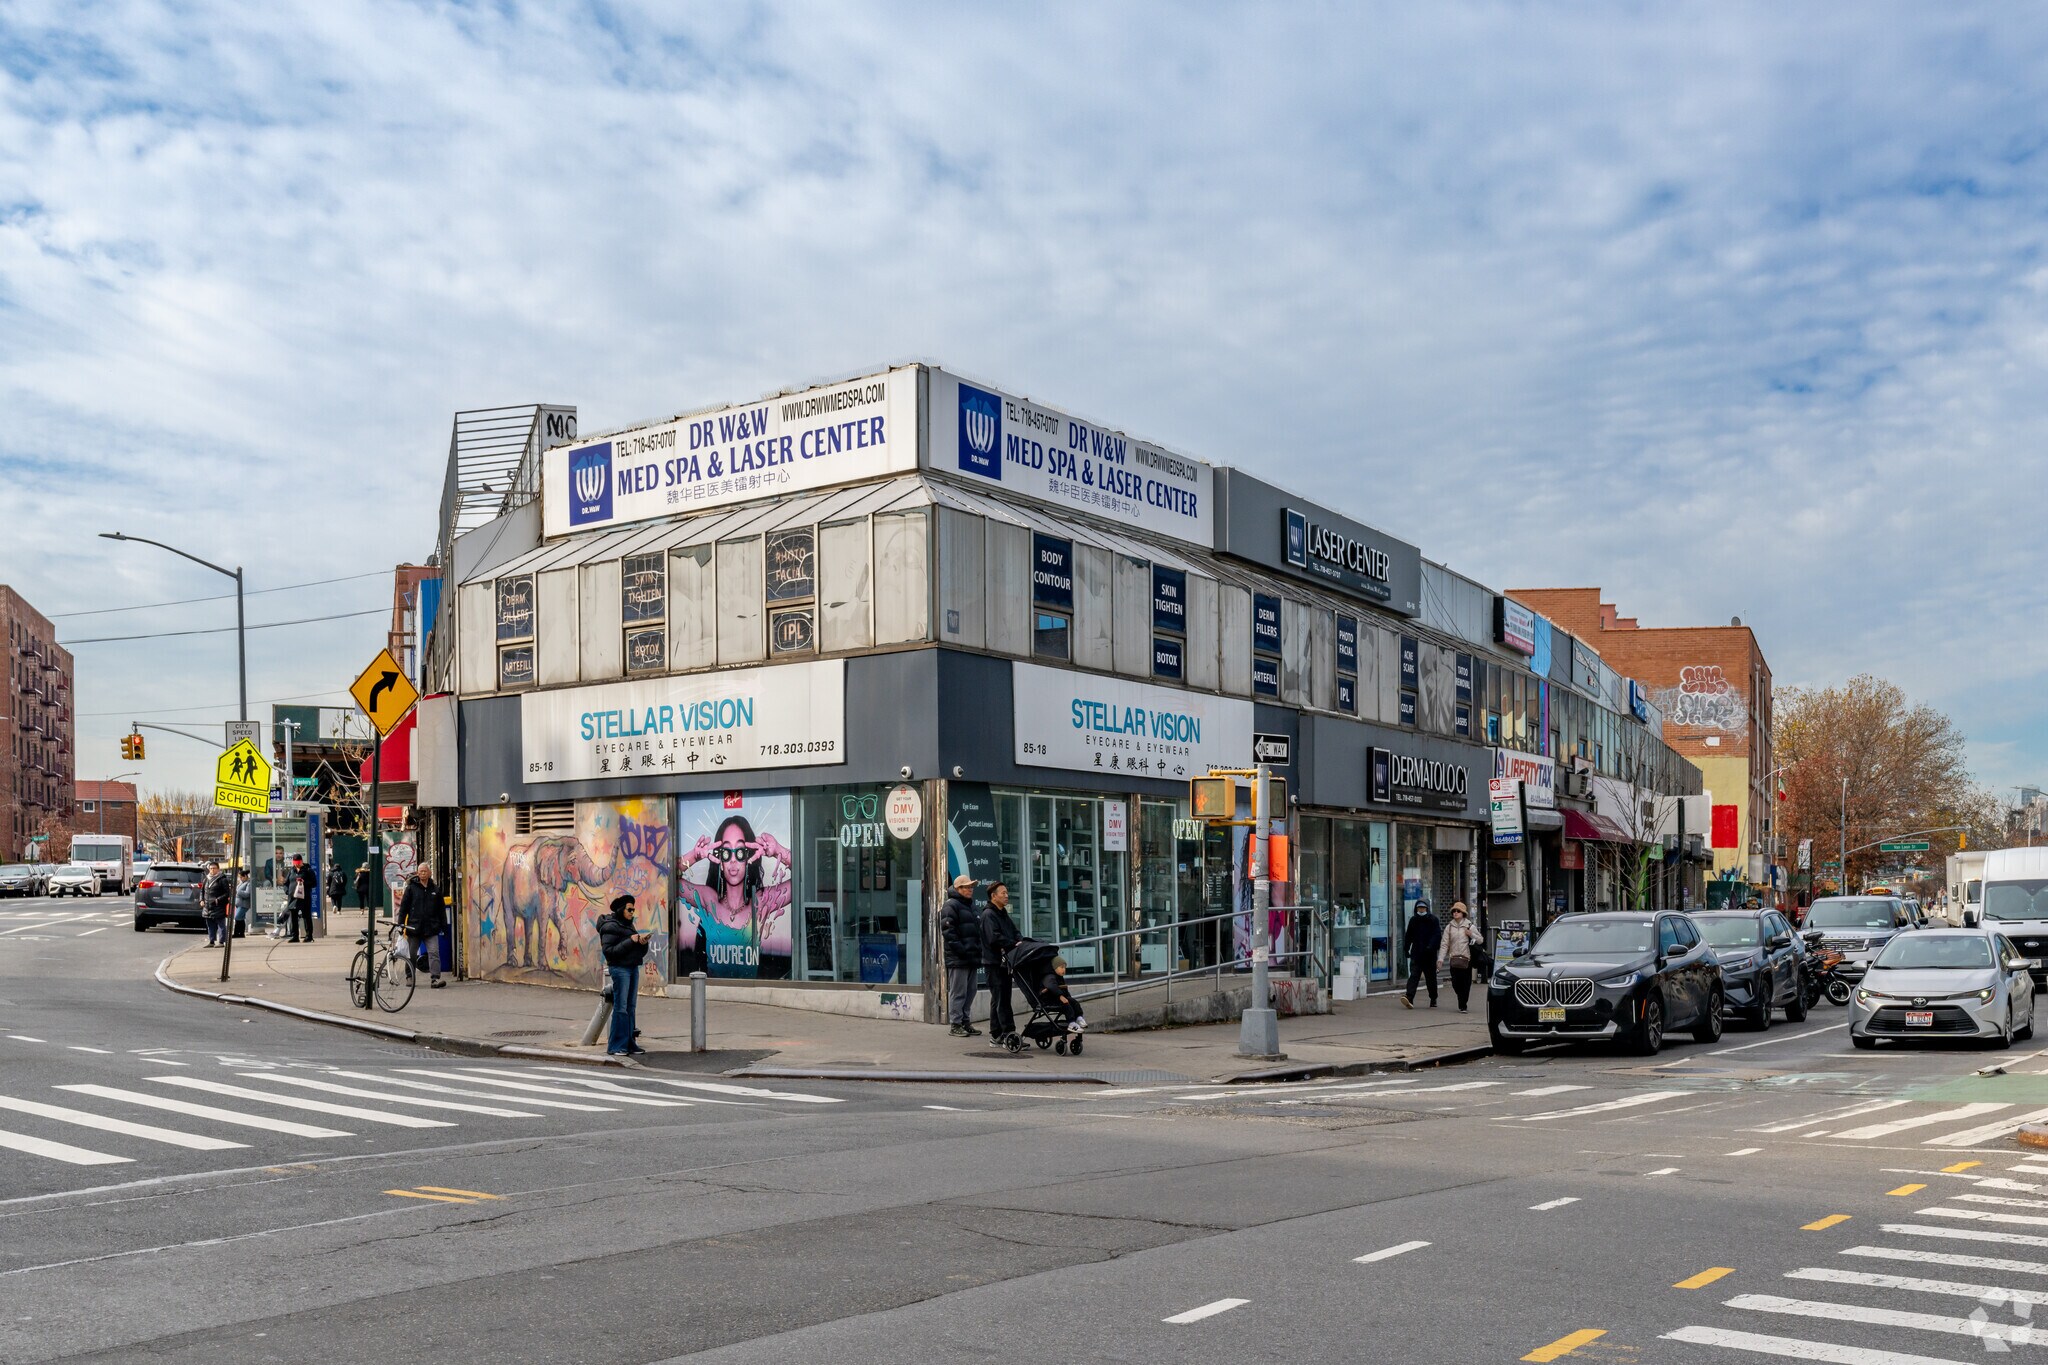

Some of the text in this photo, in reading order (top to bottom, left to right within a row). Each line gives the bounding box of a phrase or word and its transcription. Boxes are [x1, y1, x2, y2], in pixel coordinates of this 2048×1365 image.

[782, 383, 885, 422] WWW.DRWWMEDSPA.COM
[1005, 401, 1059, 436] TEL: 718-457-0707
[690, 407, 769, 450] DR W&W
[616, 430, 677, 458] TEL: 718-457-0707
[1069, 421, 1127, 466] DR W&W
[618, 415, 886, 496] MED SPA & LASER CENTER
[1006, 433, 1198, 518] MED SPA & LASER CENTER
[775, 548, 806, 563] PHOTO
[1041, 550, 1063, 566] BODY
[1307, 522, 1390, 582] LASER CENTER
[635, 573, 654, 586] SKIN
[775, 566, 807, 581] FACIAL
[1034, 570, 1071, 591] CONTOUR
[628, 588, 662, 603] TIGHTEN
[1161, 583, 1177, 598] SKIN
[505, 594, 526, 606] DERM
[1155, 598, 1183, 616] TIGHTEN
[503, 608, 529, 622] FILLERS
[1258, 608, 1275, 622] DERM
[783, 622, 804, 641] IPL
[1256, 623, 1277, 637] FILLERS
[1339, 630, 1354, 643] PHOTO
[635, 644, 660, 656] BOTOX
[1339, 644, 1354, 657] FACIAL
[1404, 650, 1414, 661] ACNE
[505, 659, 532, 672] ARTEFILL
[1156, 651, 1177, 667] BOTOX
[1403, 662, 1414, 674] SCARS
[1254, 670, 1277, 685] ARTEFILL
[1340, 687, 1350, 702] IPL
[580, 697, 753, 741] STELLAR VISION
[1071, 698, 1201, 744] STELLAR VISION
[1456, 717, 1468, 727] LASERS
[595, 734, 733, 755] EYECARE & EYEWEAR
[760, 740, 835, 756] 718.303.0393
[1023, 742, 1047, 755] 85-18
[1086, 735, 1190, 757] EYECARE & EYEWEAR
[1258, 743, 1285, 755] ONE WAY
[529, 761, 554, 773] 85-18
[1392, 754, 1471, 795] DERMATOLOGY
[219, 791, 265, 808] SCHOOL
[893, 803, 914, 815] DMV
[1108, 819, 1122, 829] DMV
[840, 822, 885, 848] OPEN
[710, 944, 760, 966] YOU'RE ON
